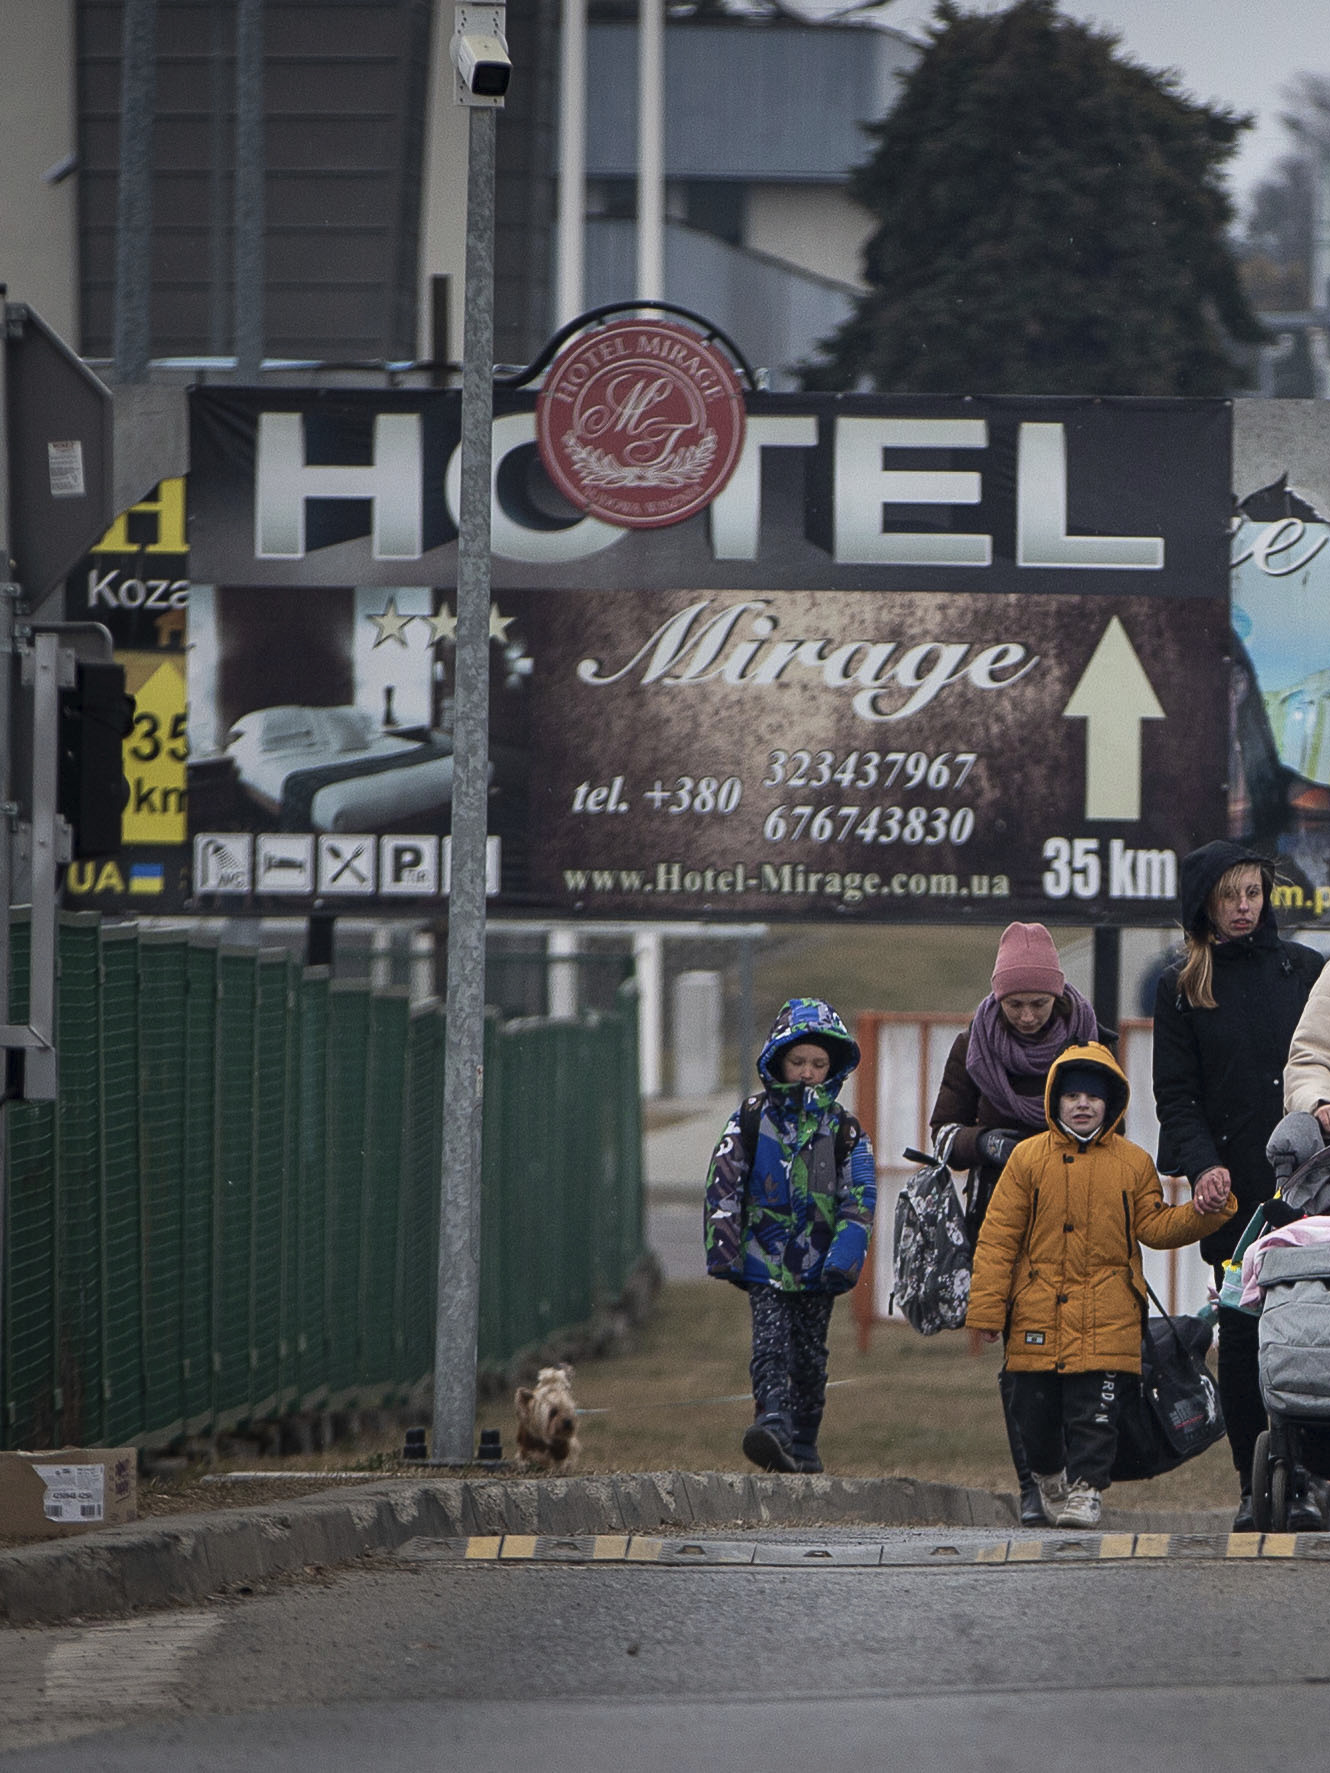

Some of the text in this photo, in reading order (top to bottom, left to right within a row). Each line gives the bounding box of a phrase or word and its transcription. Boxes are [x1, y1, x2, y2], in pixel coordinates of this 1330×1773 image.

[553, 335, 727, 404] HOTEL MIRAGE
[254, 411, 1166, 571] HOTEL
[577, 599, 1041, 723] Mirage
[762, 750, 979, 791] 323437967
[571, 775, 744, 816] tel. +380
[763, 805, 977, 846] 676743830
[67, 860, 125, 894] UA
[563, 862, 1011, 900] www.Hotel-Mirage.com.ua
[1042, 836, 1179, 900] 35 km
